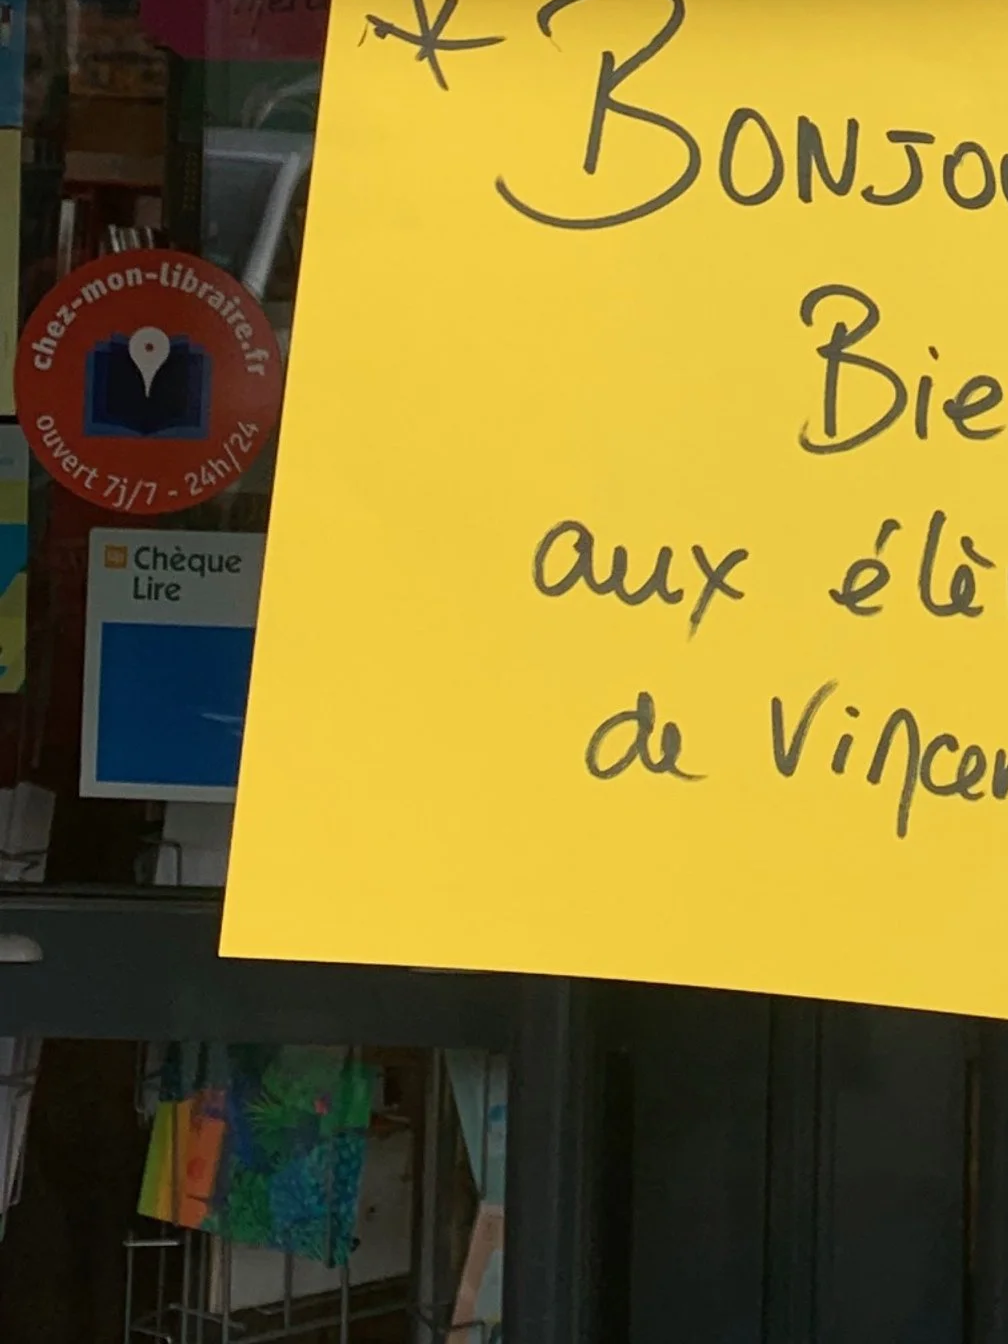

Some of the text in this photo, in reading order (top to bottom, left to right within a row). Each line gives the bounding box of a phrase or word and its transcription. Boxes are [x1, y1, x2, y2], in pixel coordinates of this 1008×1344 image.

[31, 261, 270, 376] chez-mon-libraire.fr
[35, 414, 100, 490] ouvert
[102, 474, 157, 511] 7j/7
[184, 421, 260, 496] 24h/24
[132, 576, 182, 603] Lire
[133, 545, 243, 577] Chèque
[535, 520, 750, 642] aux
[585, 691, 709, 780] de
